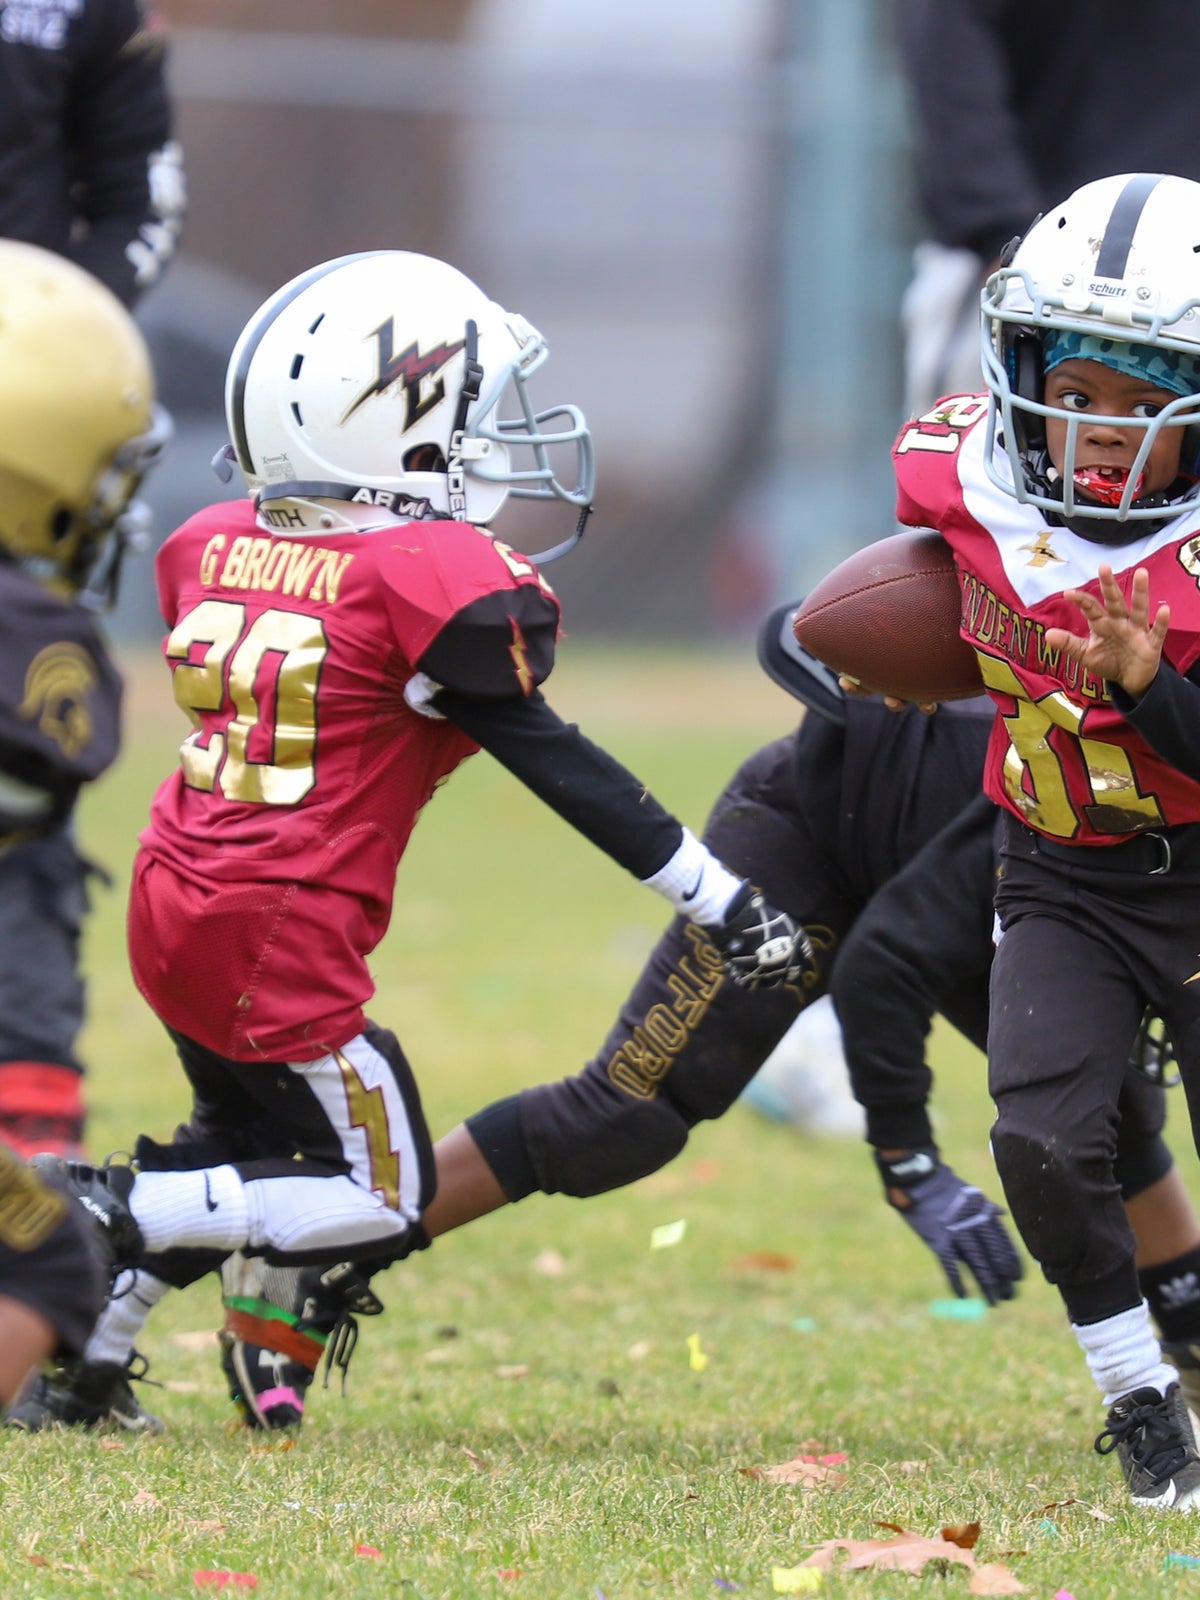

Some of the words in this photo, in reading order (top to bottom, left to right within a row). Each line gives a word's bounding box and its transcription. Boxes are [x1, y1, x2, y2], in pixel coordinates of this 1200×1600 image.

[1088, 283, 1127, 297] schutt
[201, 533, 226, 586] G
[220, 536, 354, 604] BROWN
[166, 598, 330, 805] 20
[607, 922, 726, 1101] PTFORD
